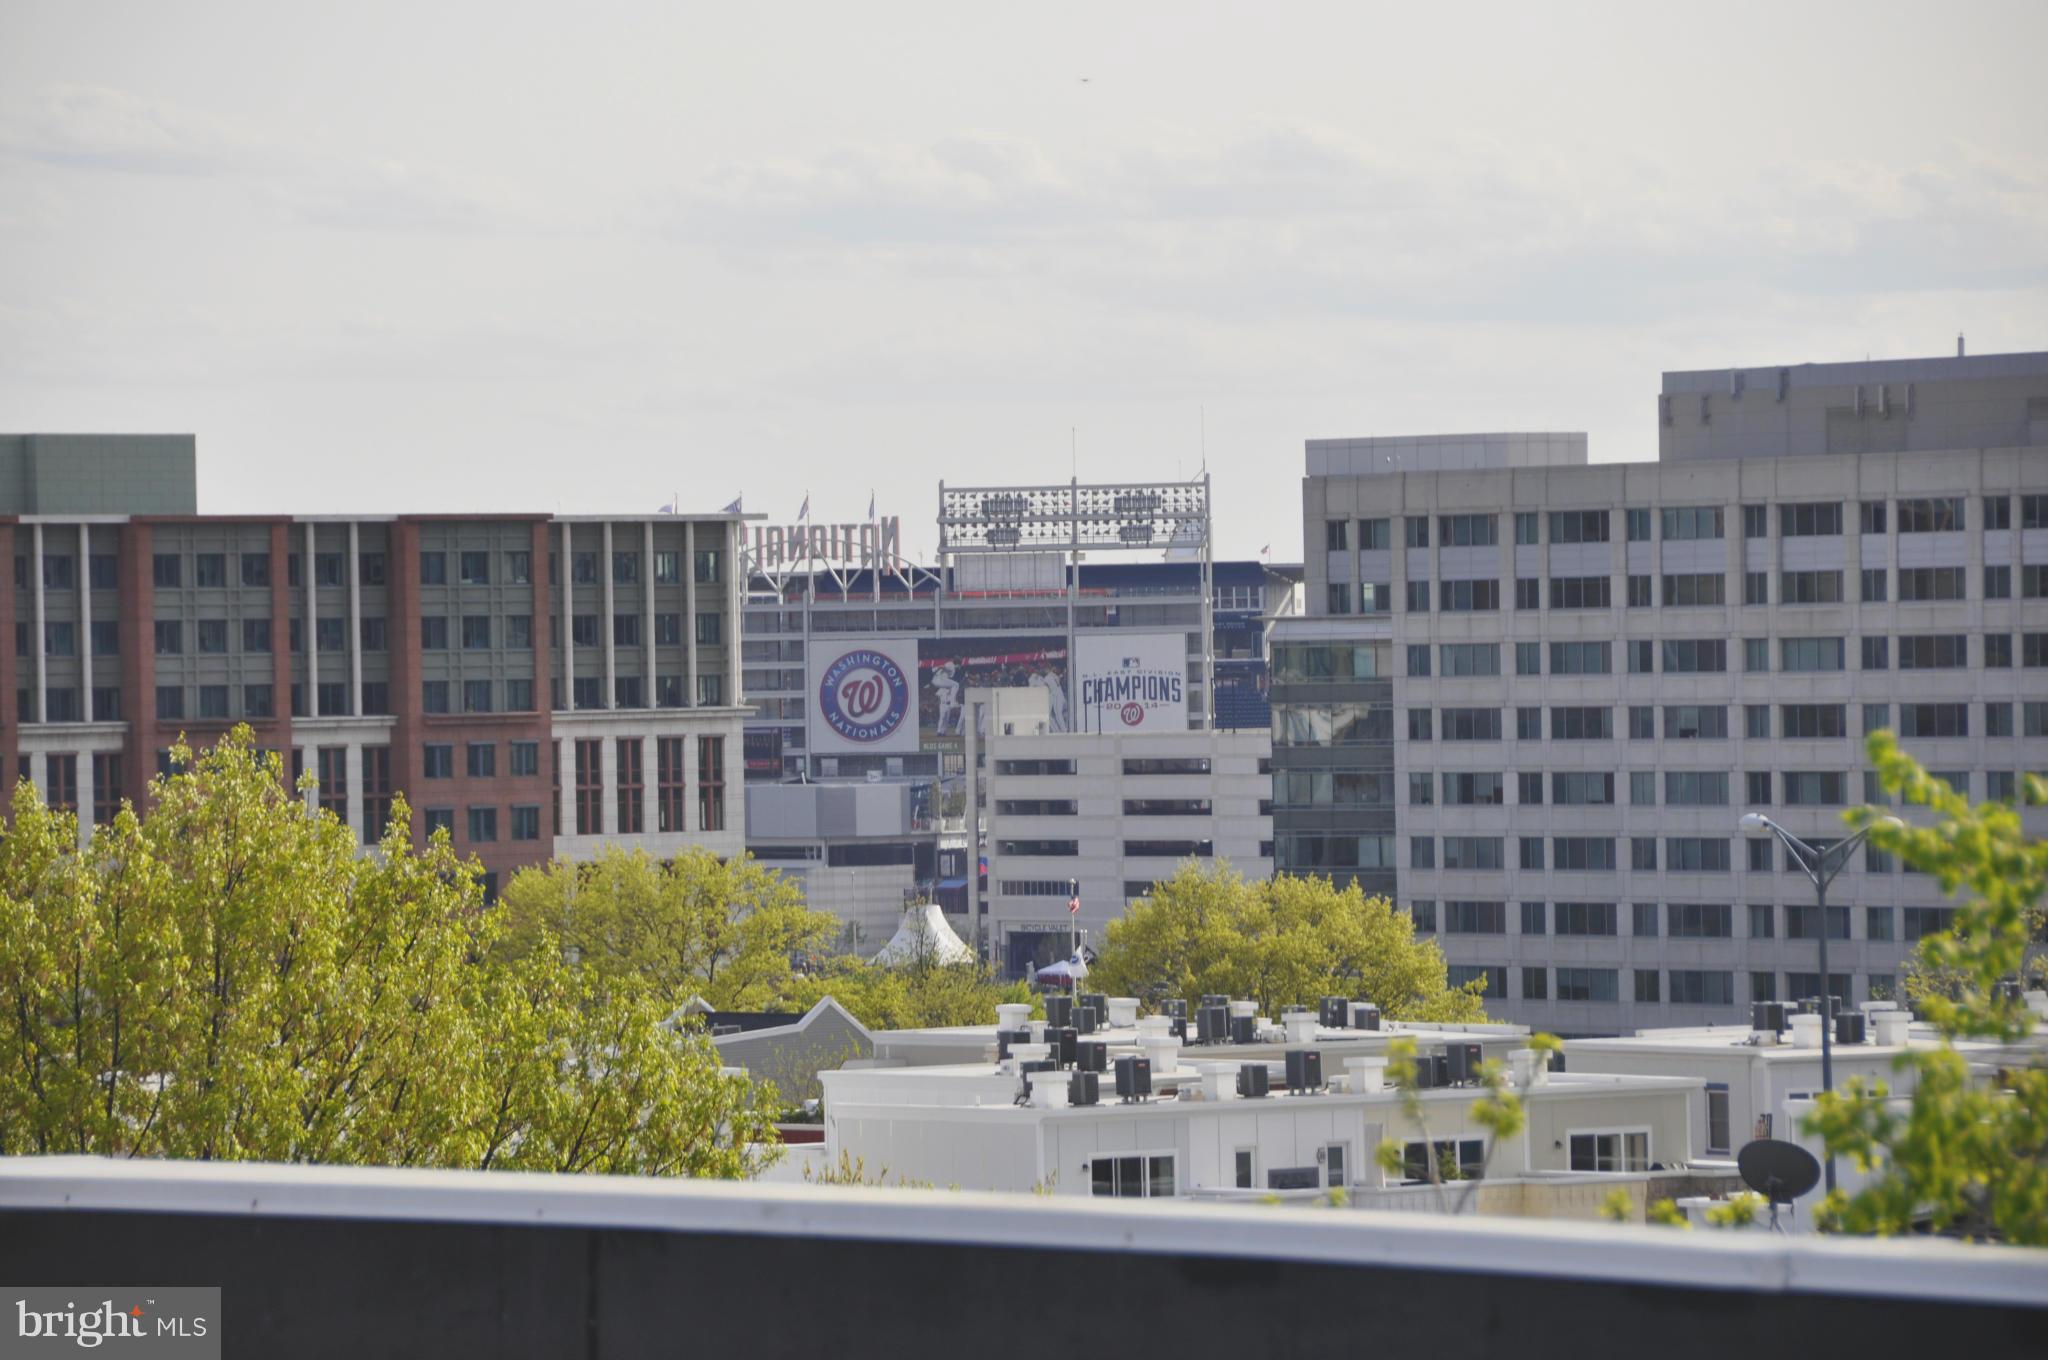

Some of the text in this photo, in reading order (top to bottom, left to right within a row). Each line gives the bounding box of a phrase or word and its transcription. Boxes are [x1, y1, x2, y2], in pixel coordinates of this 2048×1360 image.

[825, 653, 903, 687] WASHINGTON
[841, 674, 884, 718] W
[1082, 675, 1182, 705] CHAMPIONS
[829, 711, 900, 738] NATIONALS
